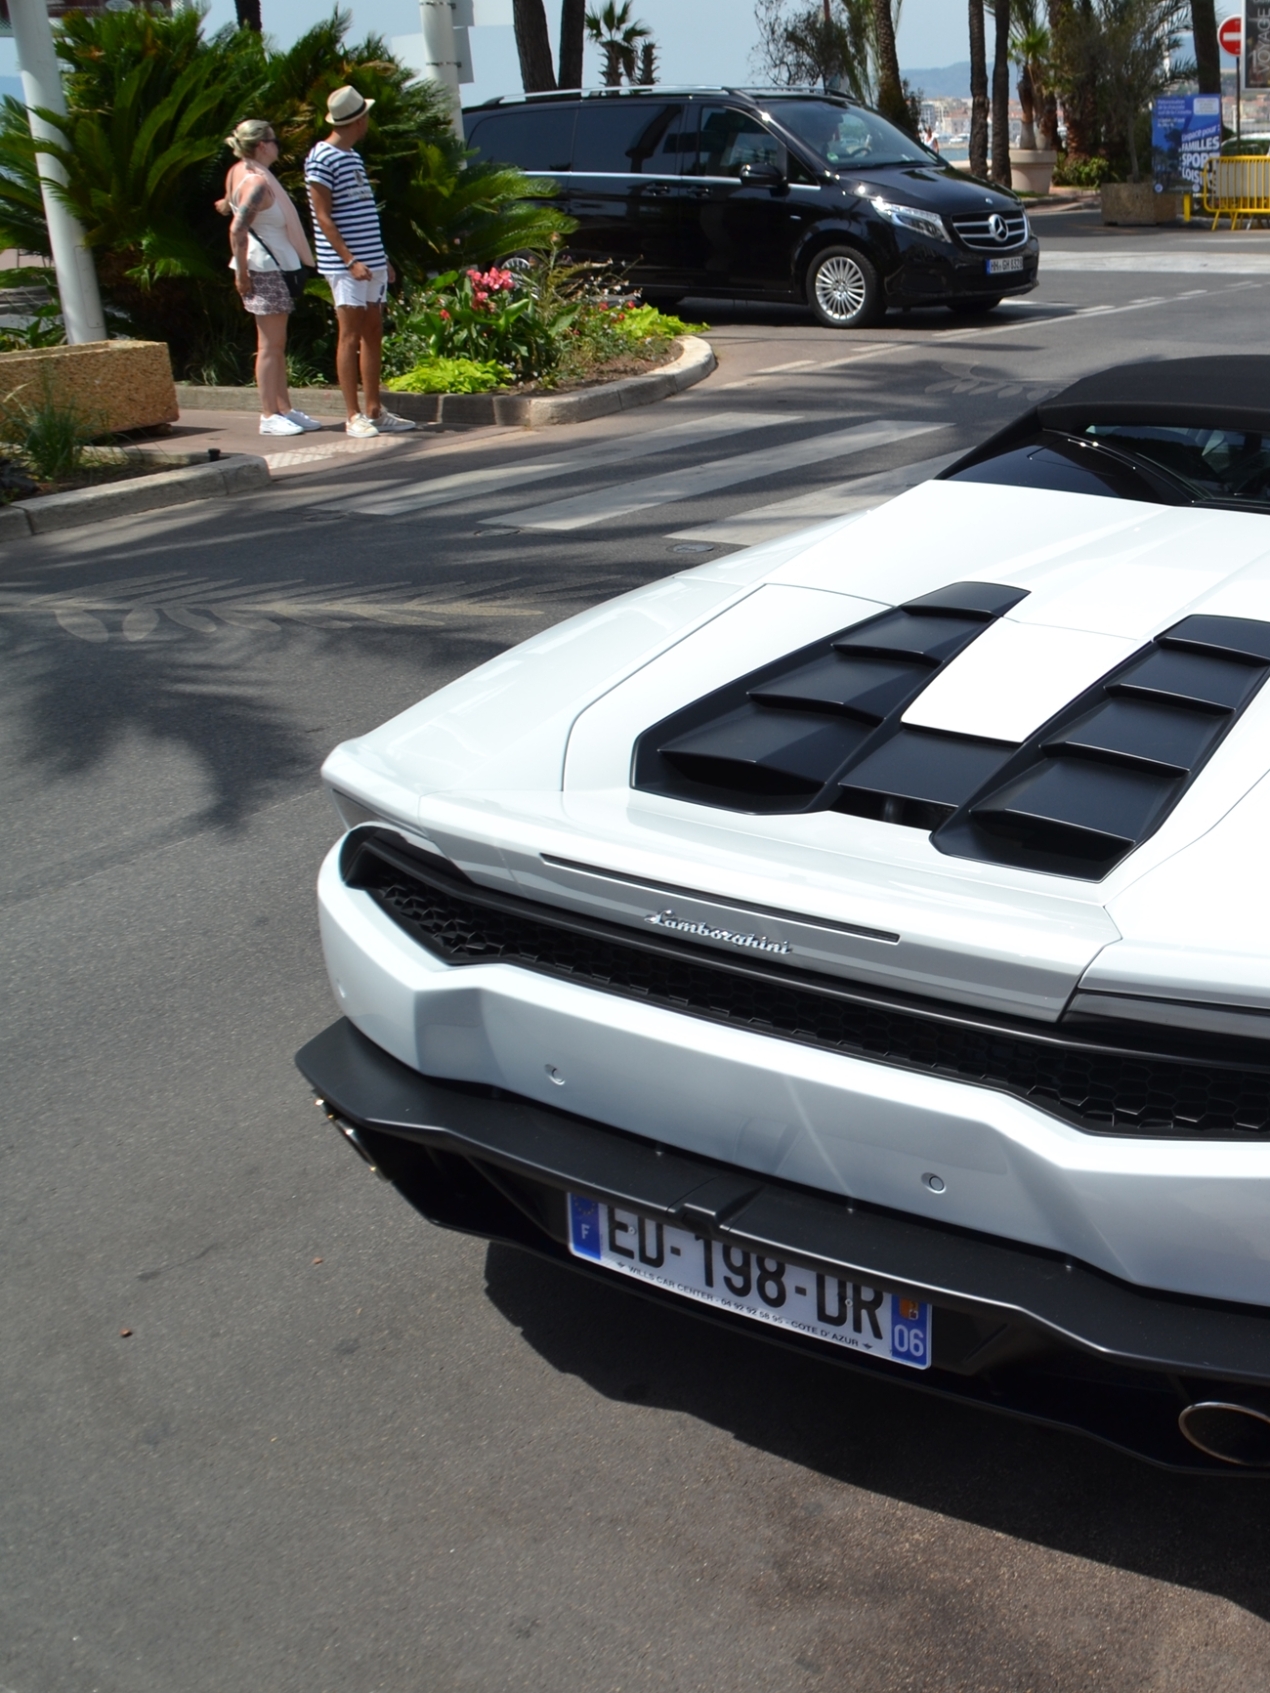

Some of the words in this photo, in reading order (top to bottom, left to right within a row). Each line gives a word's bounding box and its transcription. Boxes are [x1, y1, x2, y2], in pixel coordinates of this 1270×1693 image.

[1257, 8, 1270, 74] VOYAGE
[1181, 136, 1220, 151] FAMILLES
[644, 909, 793, 955] Lamborghini
[581, 1223, 590, 1240] F
[656, 1276, 675, 1289] CAR
[677, 1283, 714, 1303] CENTER
[831, 1332, 860, 1347] AZUR
[894, 1324, 924, 1357] 06
